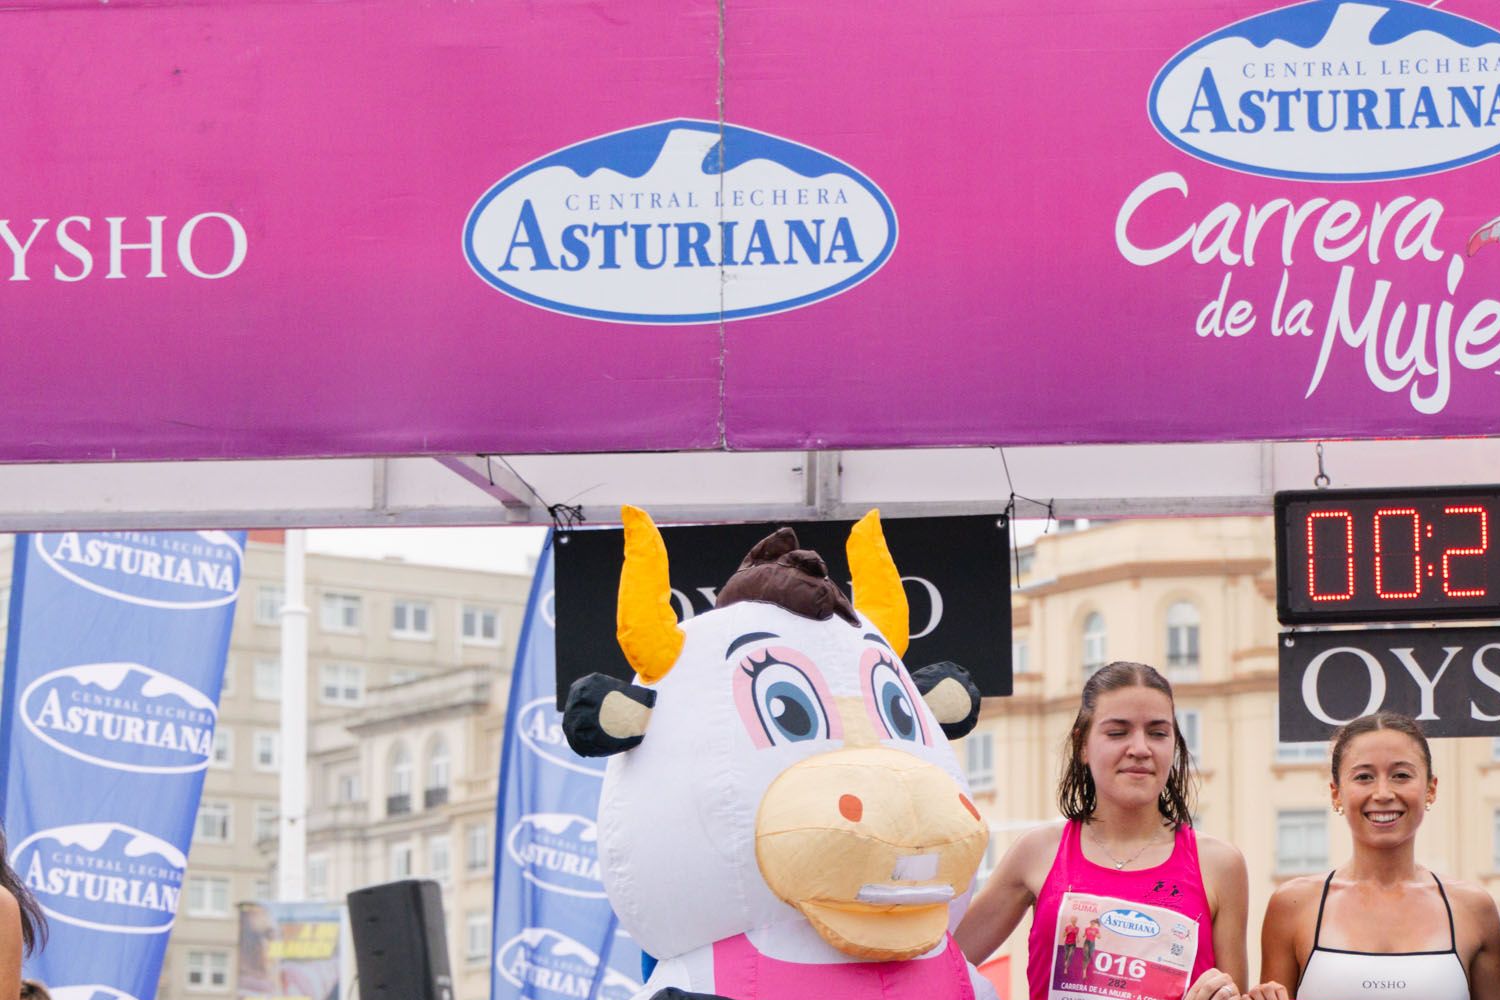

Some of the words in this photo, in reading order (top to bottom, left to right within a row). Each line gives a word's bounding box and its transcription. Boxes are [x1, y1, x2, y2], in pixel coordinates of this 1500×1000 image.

[1242, 60, 1374, 79] CENTRAL
[565, 191, 699, 212] CENTRAL
[714, 187, 849, 208] LECHERA
[1114, 171, 1444, 267] Carrera
[497, 199, 864, 272] ASTURIANA
[1195, 270, 1257, 338] de
[1272, 270, 1314, 338] la
[53, 532, 235, 592] ASTURIANA
[35, 687, 213, 758] ASTURIANA
[1072, 902, 1098, 914] SUMA
[1105, 914, 1157, 935] ASTURIANA
[1095, 952, 1147, 979] 016
[1060, 981, 1088, 992] CARRERA
[1088, 985, 1099, 994] DE
[1109, 988, 1132, 999] MUJER
[1107, 977, 1127, 989] 282
[1362, 979, 1407, 991] OYSHO
